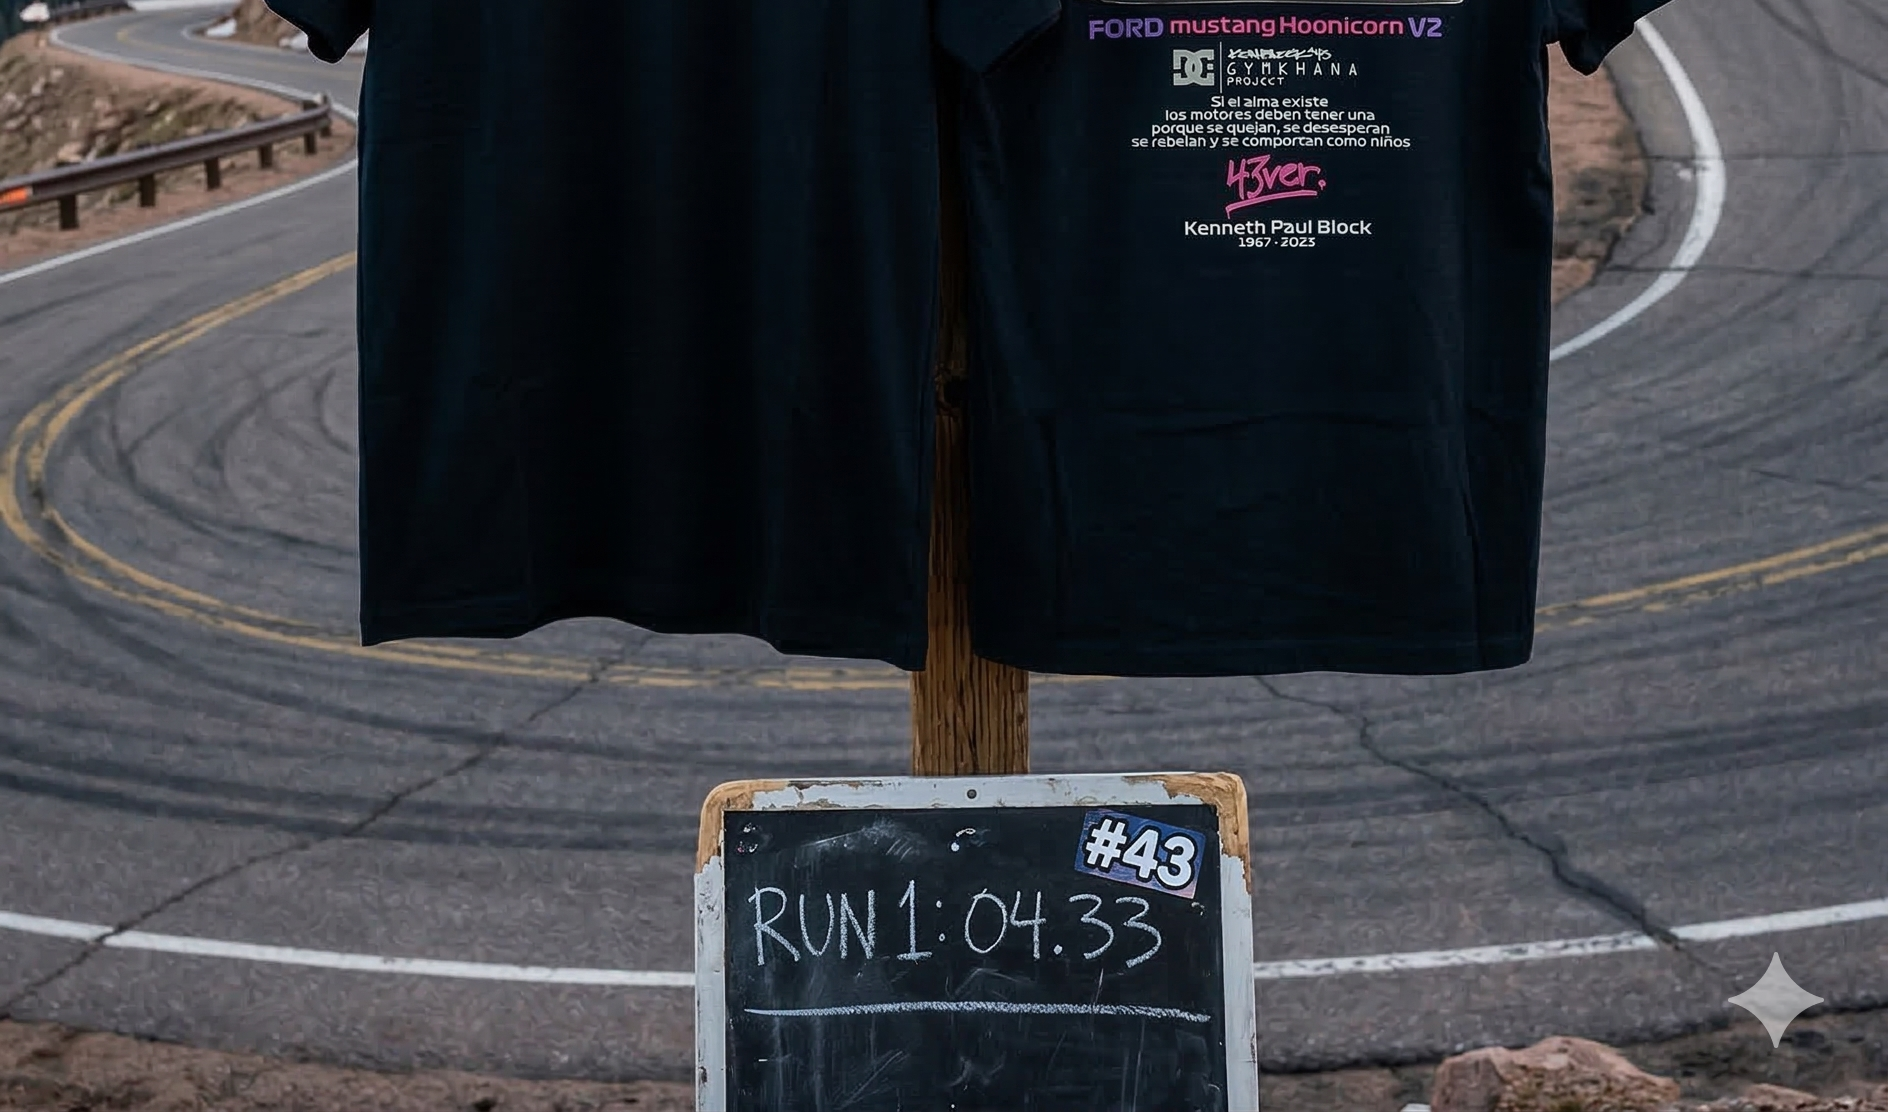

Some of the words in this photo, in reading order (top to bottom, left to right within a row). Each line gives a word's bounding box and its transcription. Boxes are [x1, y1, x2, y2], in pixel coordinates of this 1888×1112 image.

[1090, 18, 1163, 39] FORD
[1171, 17, 1275, 37] mustang
[1280, 17, 1403, 34] Hoonicorn
[1408, 18, 1442, 37] V2
[1227, 62, 1357, 75] GYMKHANA
[1211, 96, 1224, 107] Si
[1228, 96, 1240, 107] el
[1244, 96, 1279, 107] alma
[1282, 96, 1328, 107] existe
[1166, 110, 1186, 120] los
[1191, 109, 1251, 120] motores
[1255, 109, 1301, 120] deben
[1304, 109, 1345, 120] tener
[1348, 111, 1375, 120] una
[1152, 124, 1203, 136] porque
[1207, 124, 1223, 133] se
[1227, 121, 1280, 136] quejan,
[1283, 124, 1300, 133] se
[1303, 122, 1389, 136] desesperan
[1132, 138, 1148, 147] se
[1152, 136, 1206, 147] rebelan
[1210, 137, 1219, 148] y
[1222, 137, 1238, 146] se
[1242, 137, 1323, 148] comportan
[1327, 137, 1366, 147] como
[1371, 136, 1410, 147] niños
[1185, 221, 1265, 235] Kenneth
[1272, 220, 1312, 234] Paul
[1318, 220, 1372, 234] Block
[1239, 237, 1271, 247] 1967
[1281, 237, 1315, 247] 2023
[1083, 817, 1199, 891] #43
[748, 886, 875, 965] RUN
